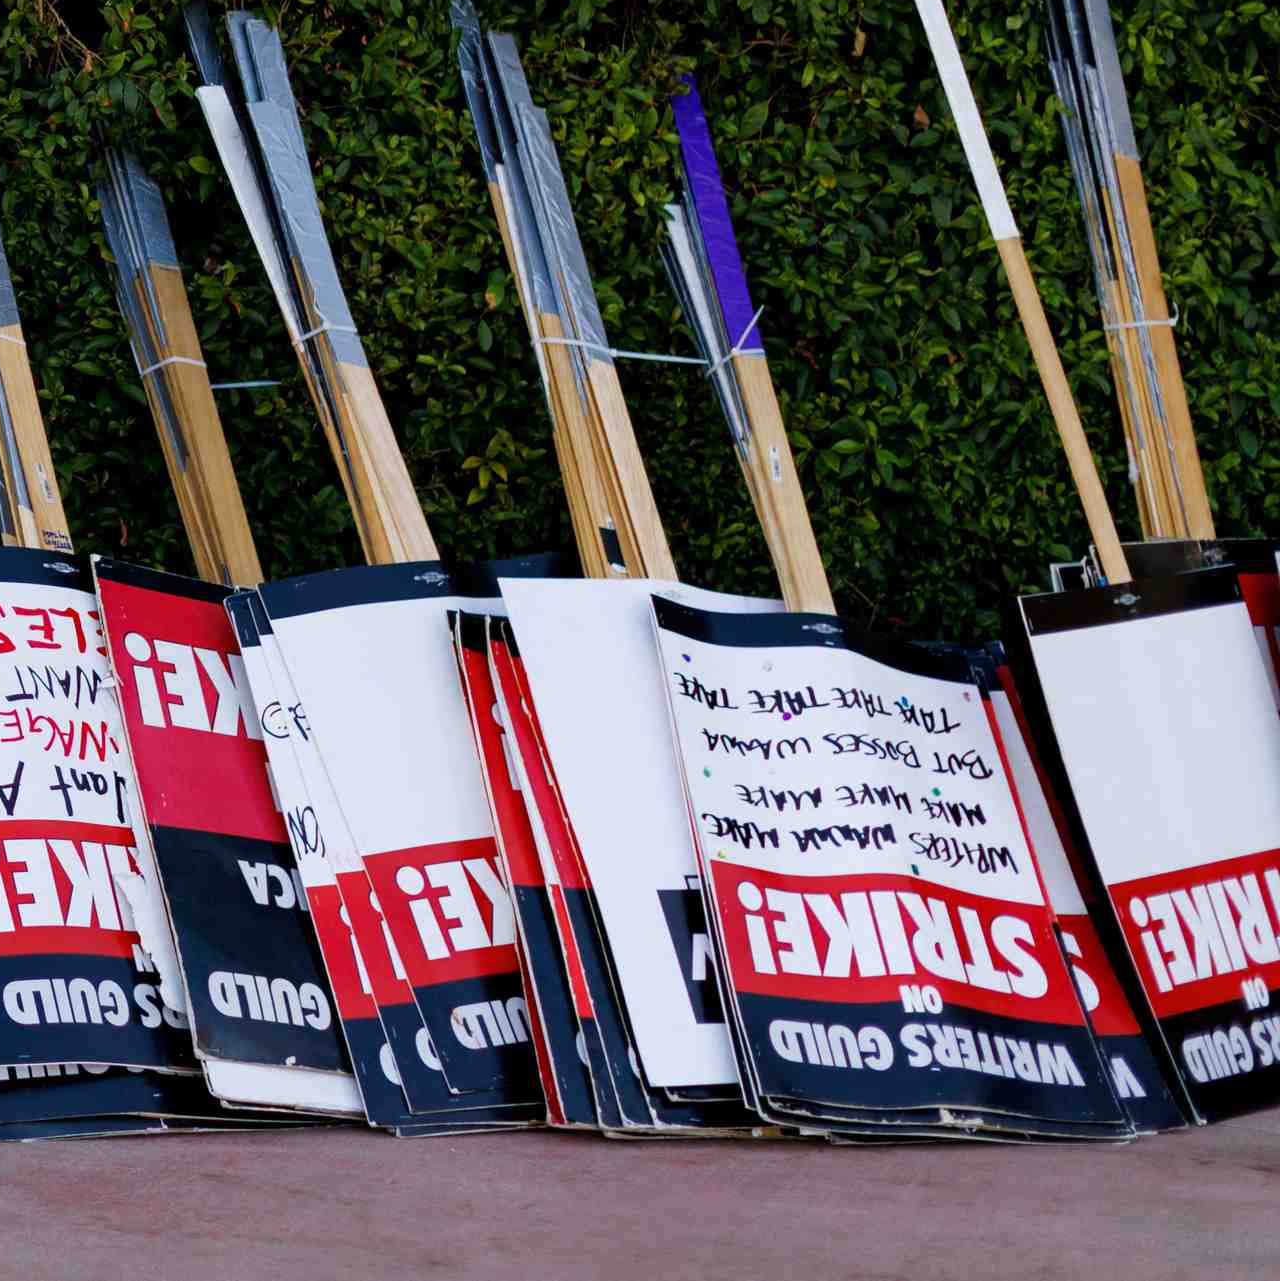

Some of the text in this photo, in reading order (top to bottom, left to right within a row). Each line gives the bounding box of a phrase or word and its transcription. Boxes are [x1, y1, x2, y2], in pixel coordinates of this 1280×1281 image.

[673, 673, 738, 710] TAKE
[747, 687, 829, 716] TAKE
[830, 687, 892, 718] TAKE
[702, 728, 992, 779] BUT BOSSES WANNA
[734, 783, 987, 826] MAKE MAKE MAKE
[702, 813, 1019, 874] WRITERS WANNA MAKE
[737, 881, 1048, 1000] STRIKE!
[2, 978, 129, 1026] GUILD
[207, 971, 332, 1032] GUILD
[900, 984, 943, 1015] ON
[1241, 977, 1269, 1010] ON
[769, 1019, 893, 1071] GUILD
[900, 1024, 1086, 1087] WRITERS
[1181, 1029, 1253, 1084] GUILD
